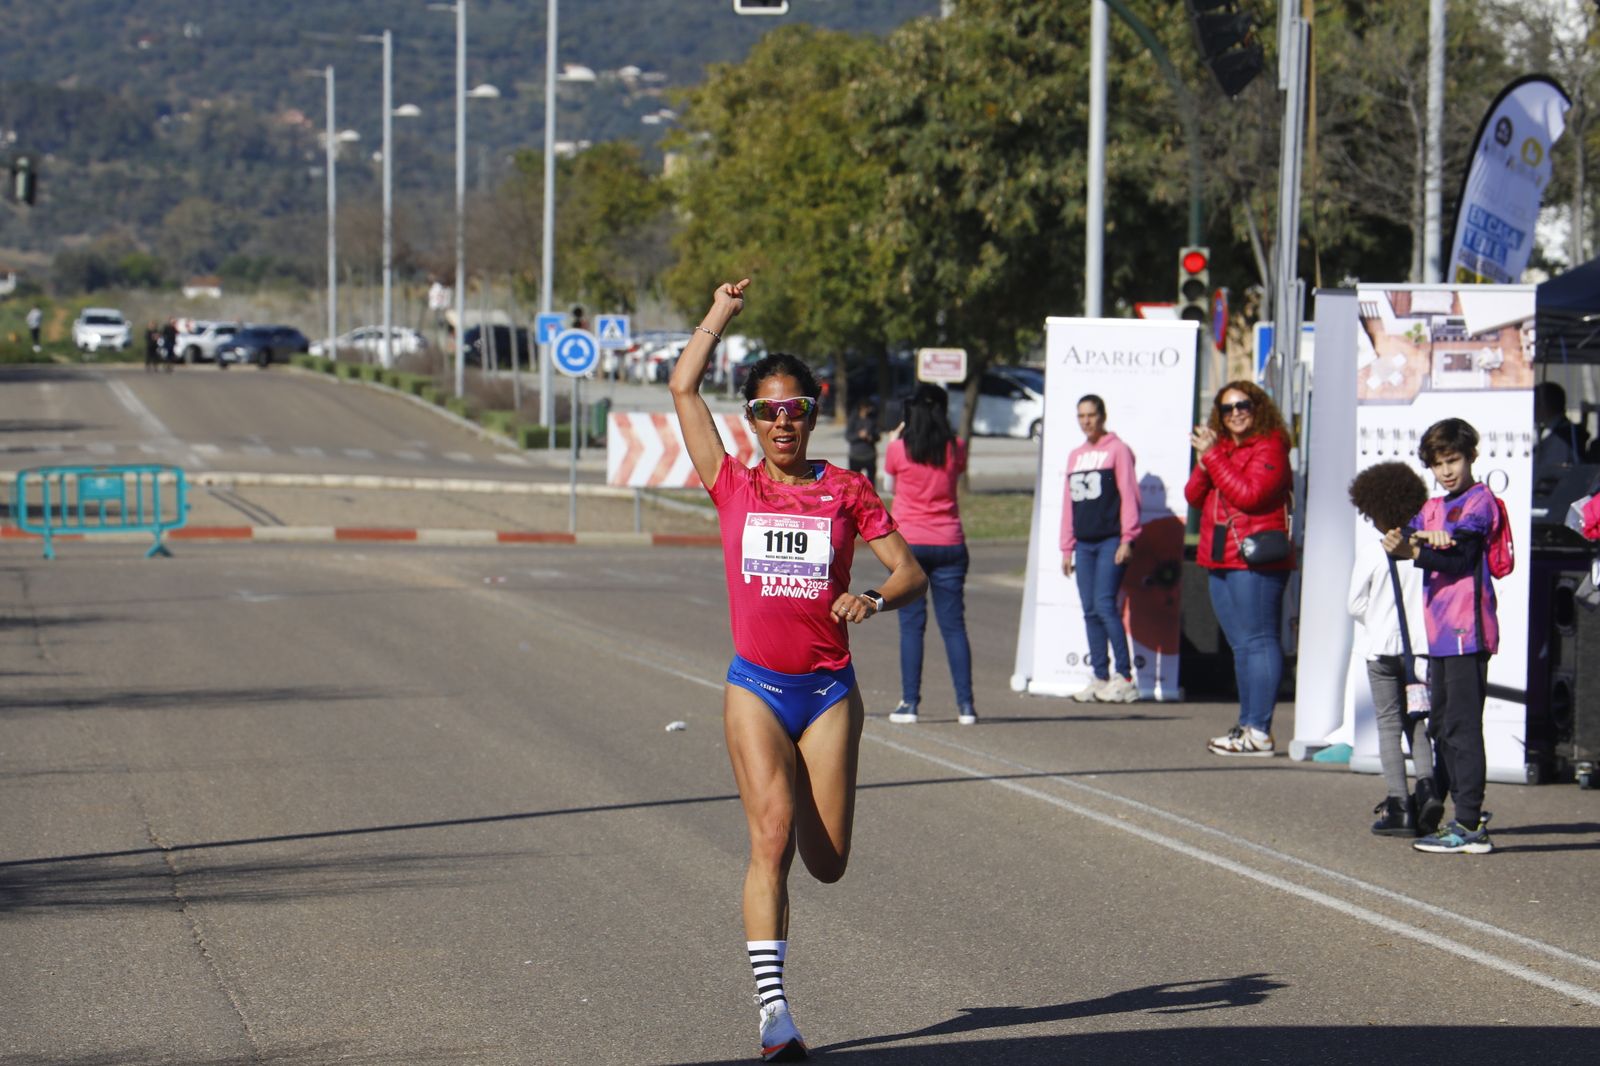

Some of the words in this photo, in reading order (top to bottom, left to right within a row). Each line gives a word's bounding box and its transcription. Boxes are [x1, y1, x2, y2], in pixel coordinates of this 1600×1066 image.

[1063, 345, 1179, 368] APARICIO
[1069, 471, 1102, 502] 53
[764, 530, 808, 554] 1119
[761, 585, 819, 600] RUNNING
[807, 580, 828, 590] 2022
